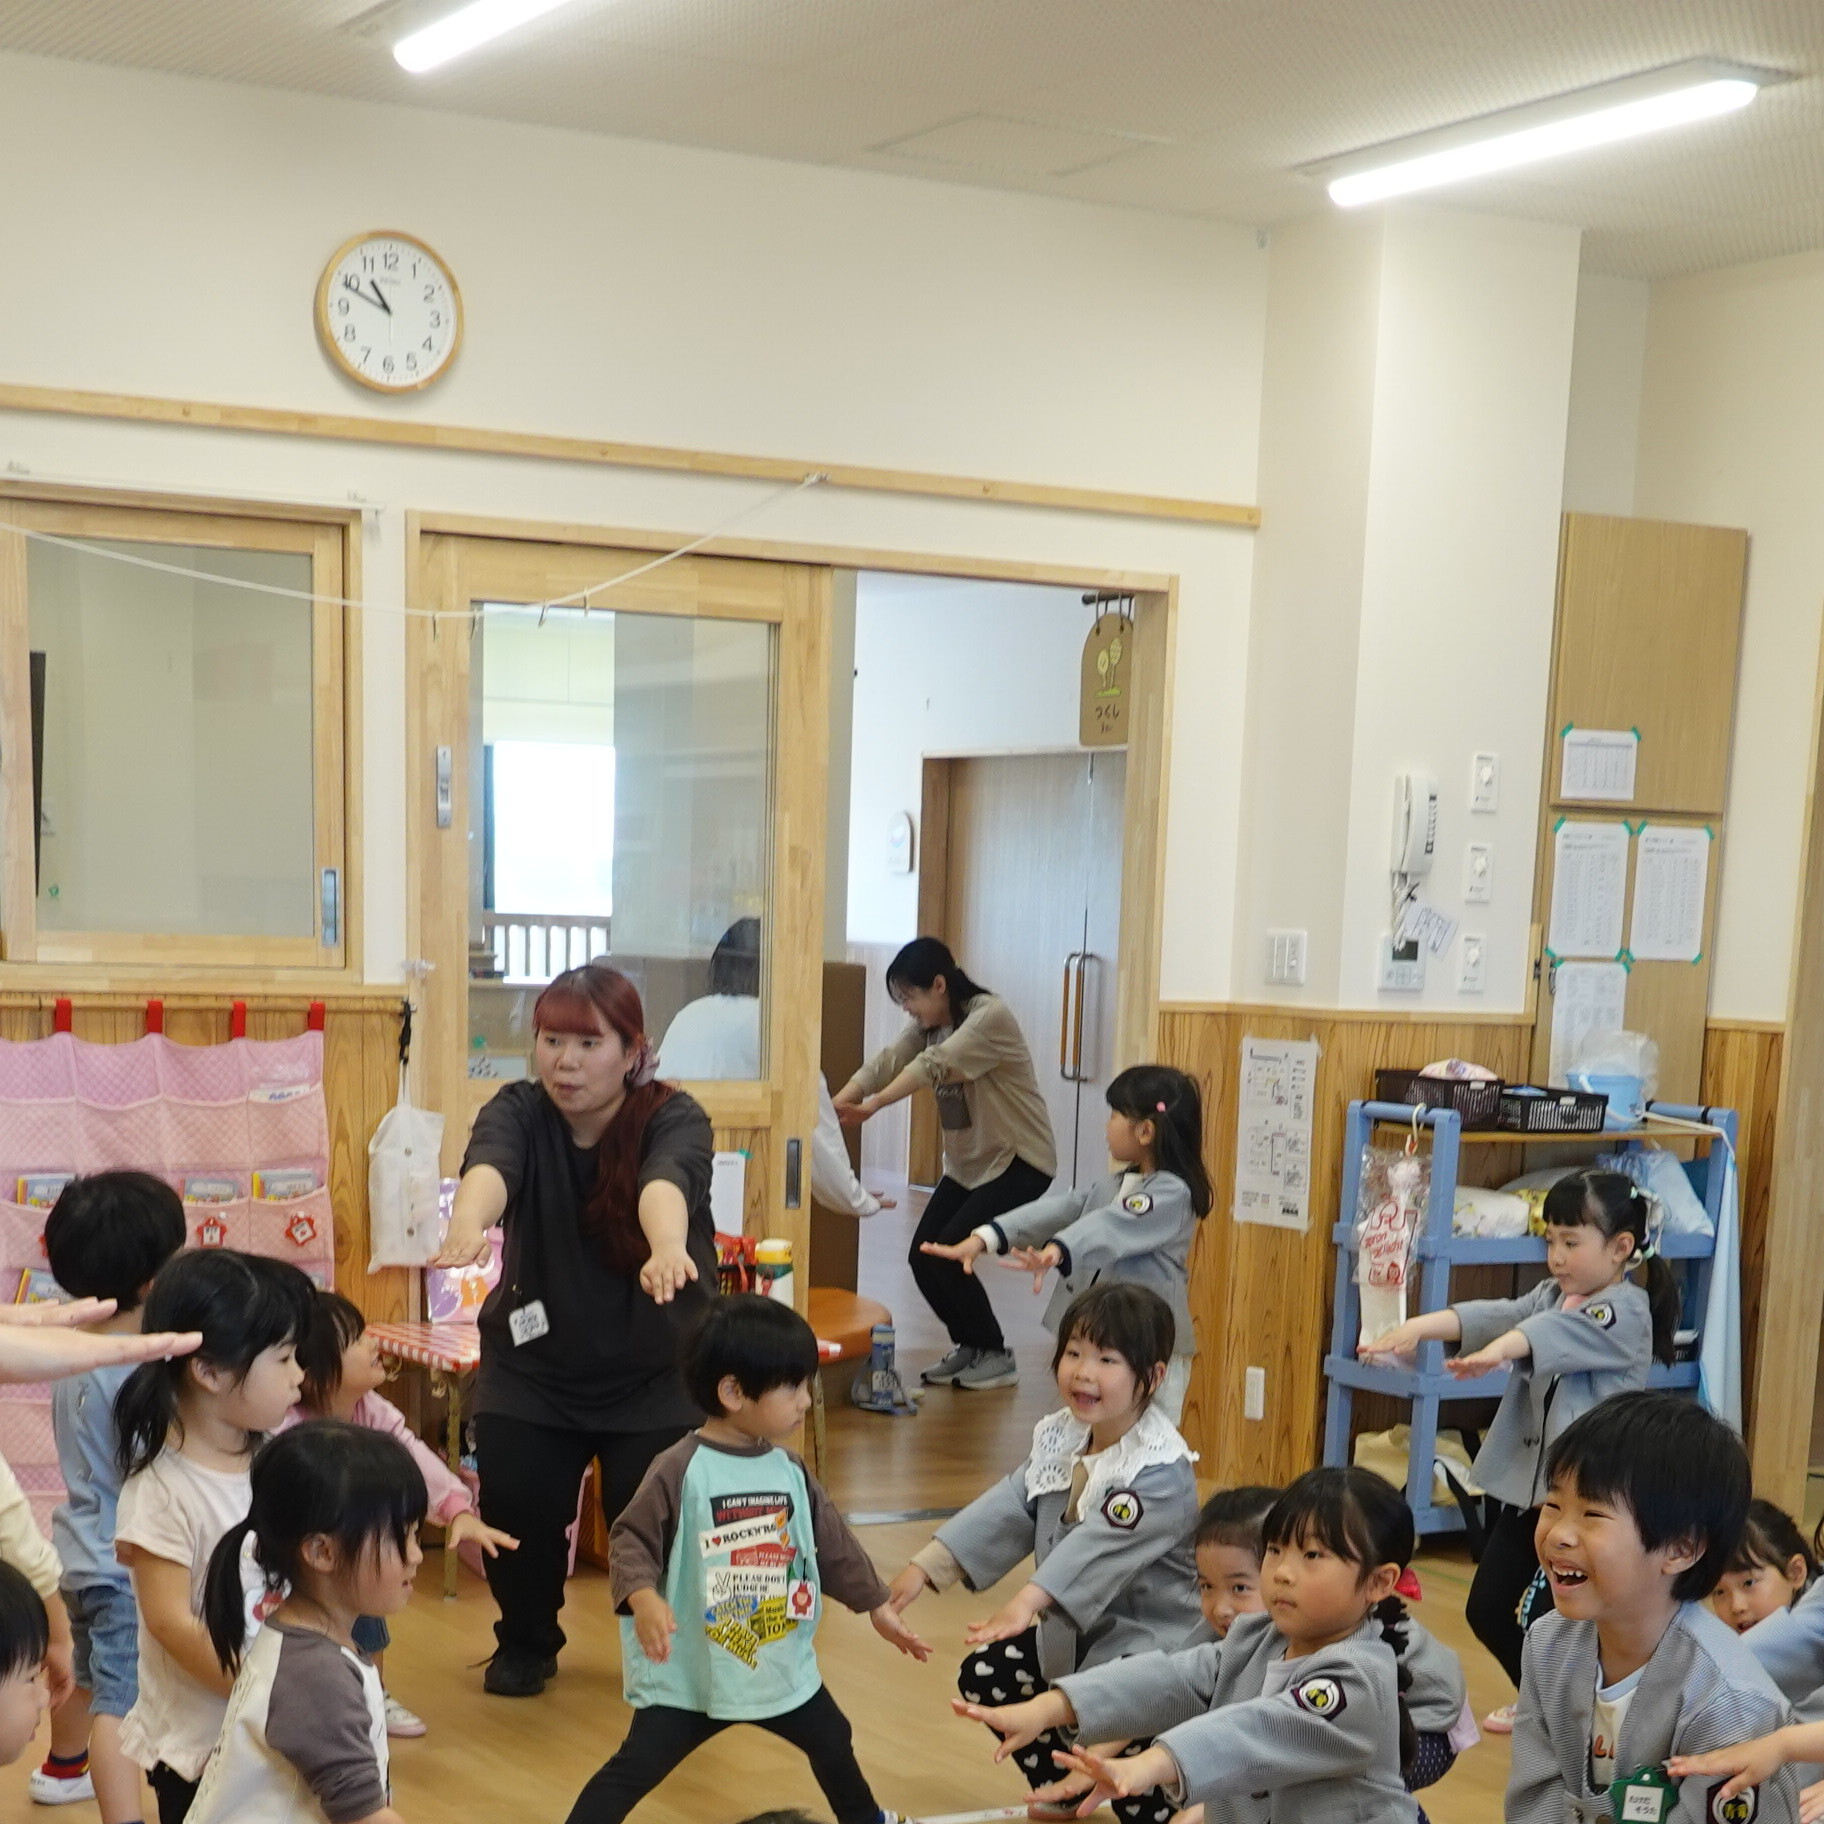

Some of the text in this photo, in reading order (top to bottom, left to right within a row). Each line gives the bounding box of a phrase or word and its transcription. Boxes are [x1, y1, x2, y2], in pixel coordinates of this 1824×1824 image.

[363, 256, 375, 273] 11
[383, 252, 399, 271] 12
[412, 262, 417, 280] 1
[344, 273, 360, 292] 10
[423, 284, 435, 303] 2
[338, 297, 350, 315] 9
[430, 310, 441, 329] 3
[344, 324, 356, 343] 8
[422, 336, 433, 353] 4
[361, 346, 372, 364] 7
[383, 355, 394, 374] 6
[406, 352, 417, 371] 5
